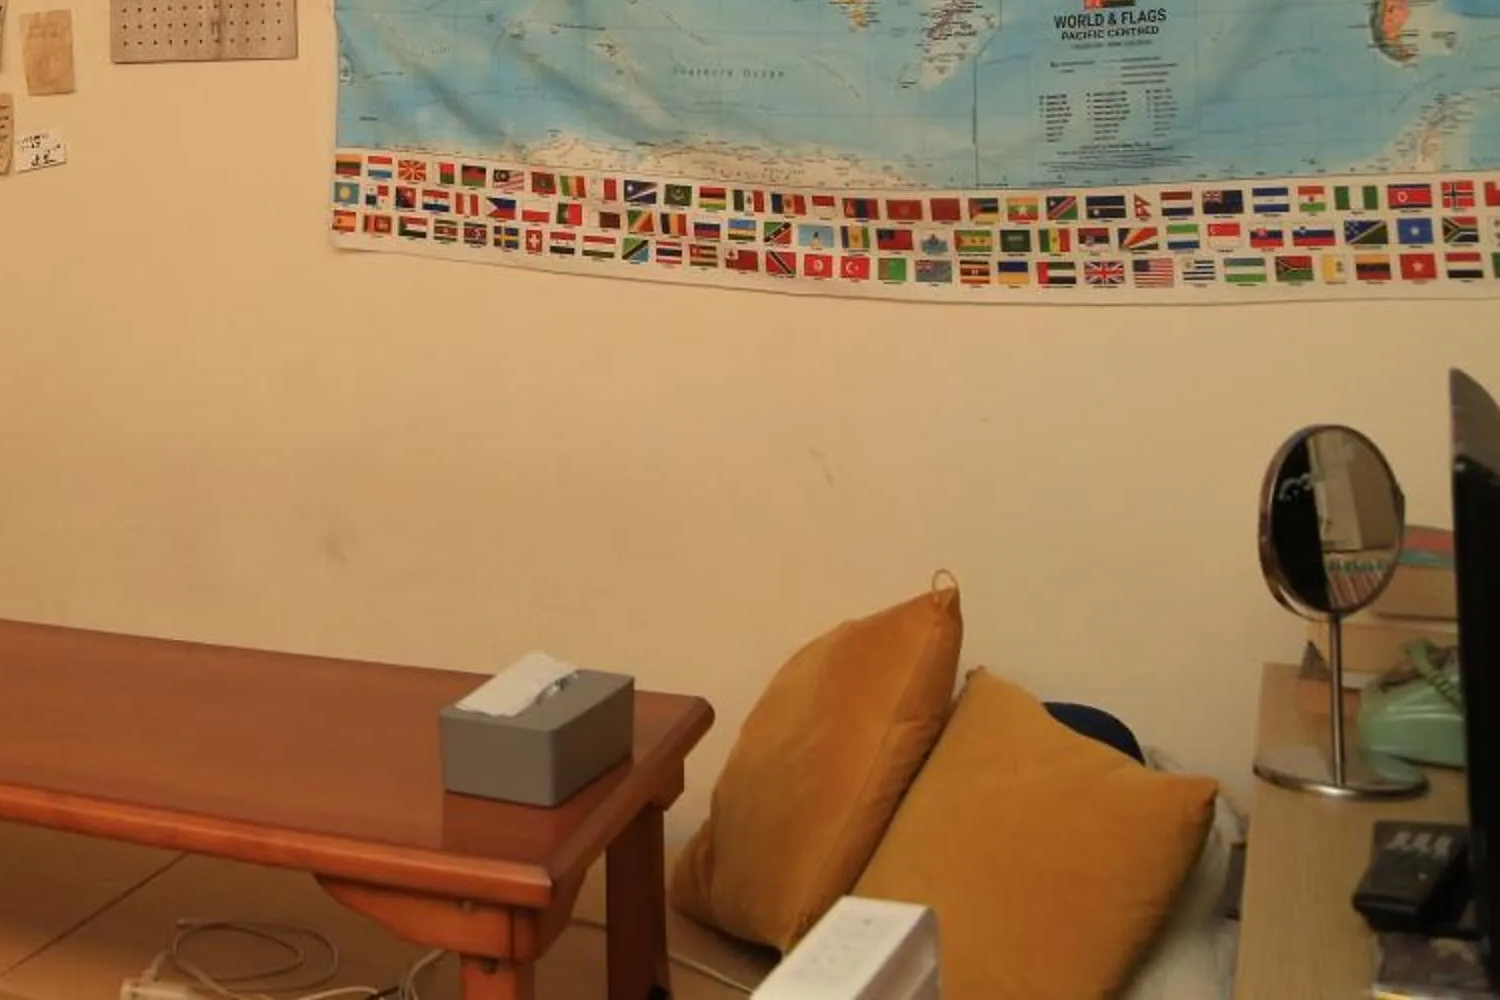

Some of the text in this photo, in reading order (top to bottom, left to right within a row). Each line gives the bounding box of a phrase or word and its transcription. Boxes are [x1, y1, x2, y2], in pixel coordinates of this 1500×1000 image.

[1054, 8, 1167, 29] WORLD & FLAGS
[1061, 25, 1159, 41] PACIFIC CENTRED
